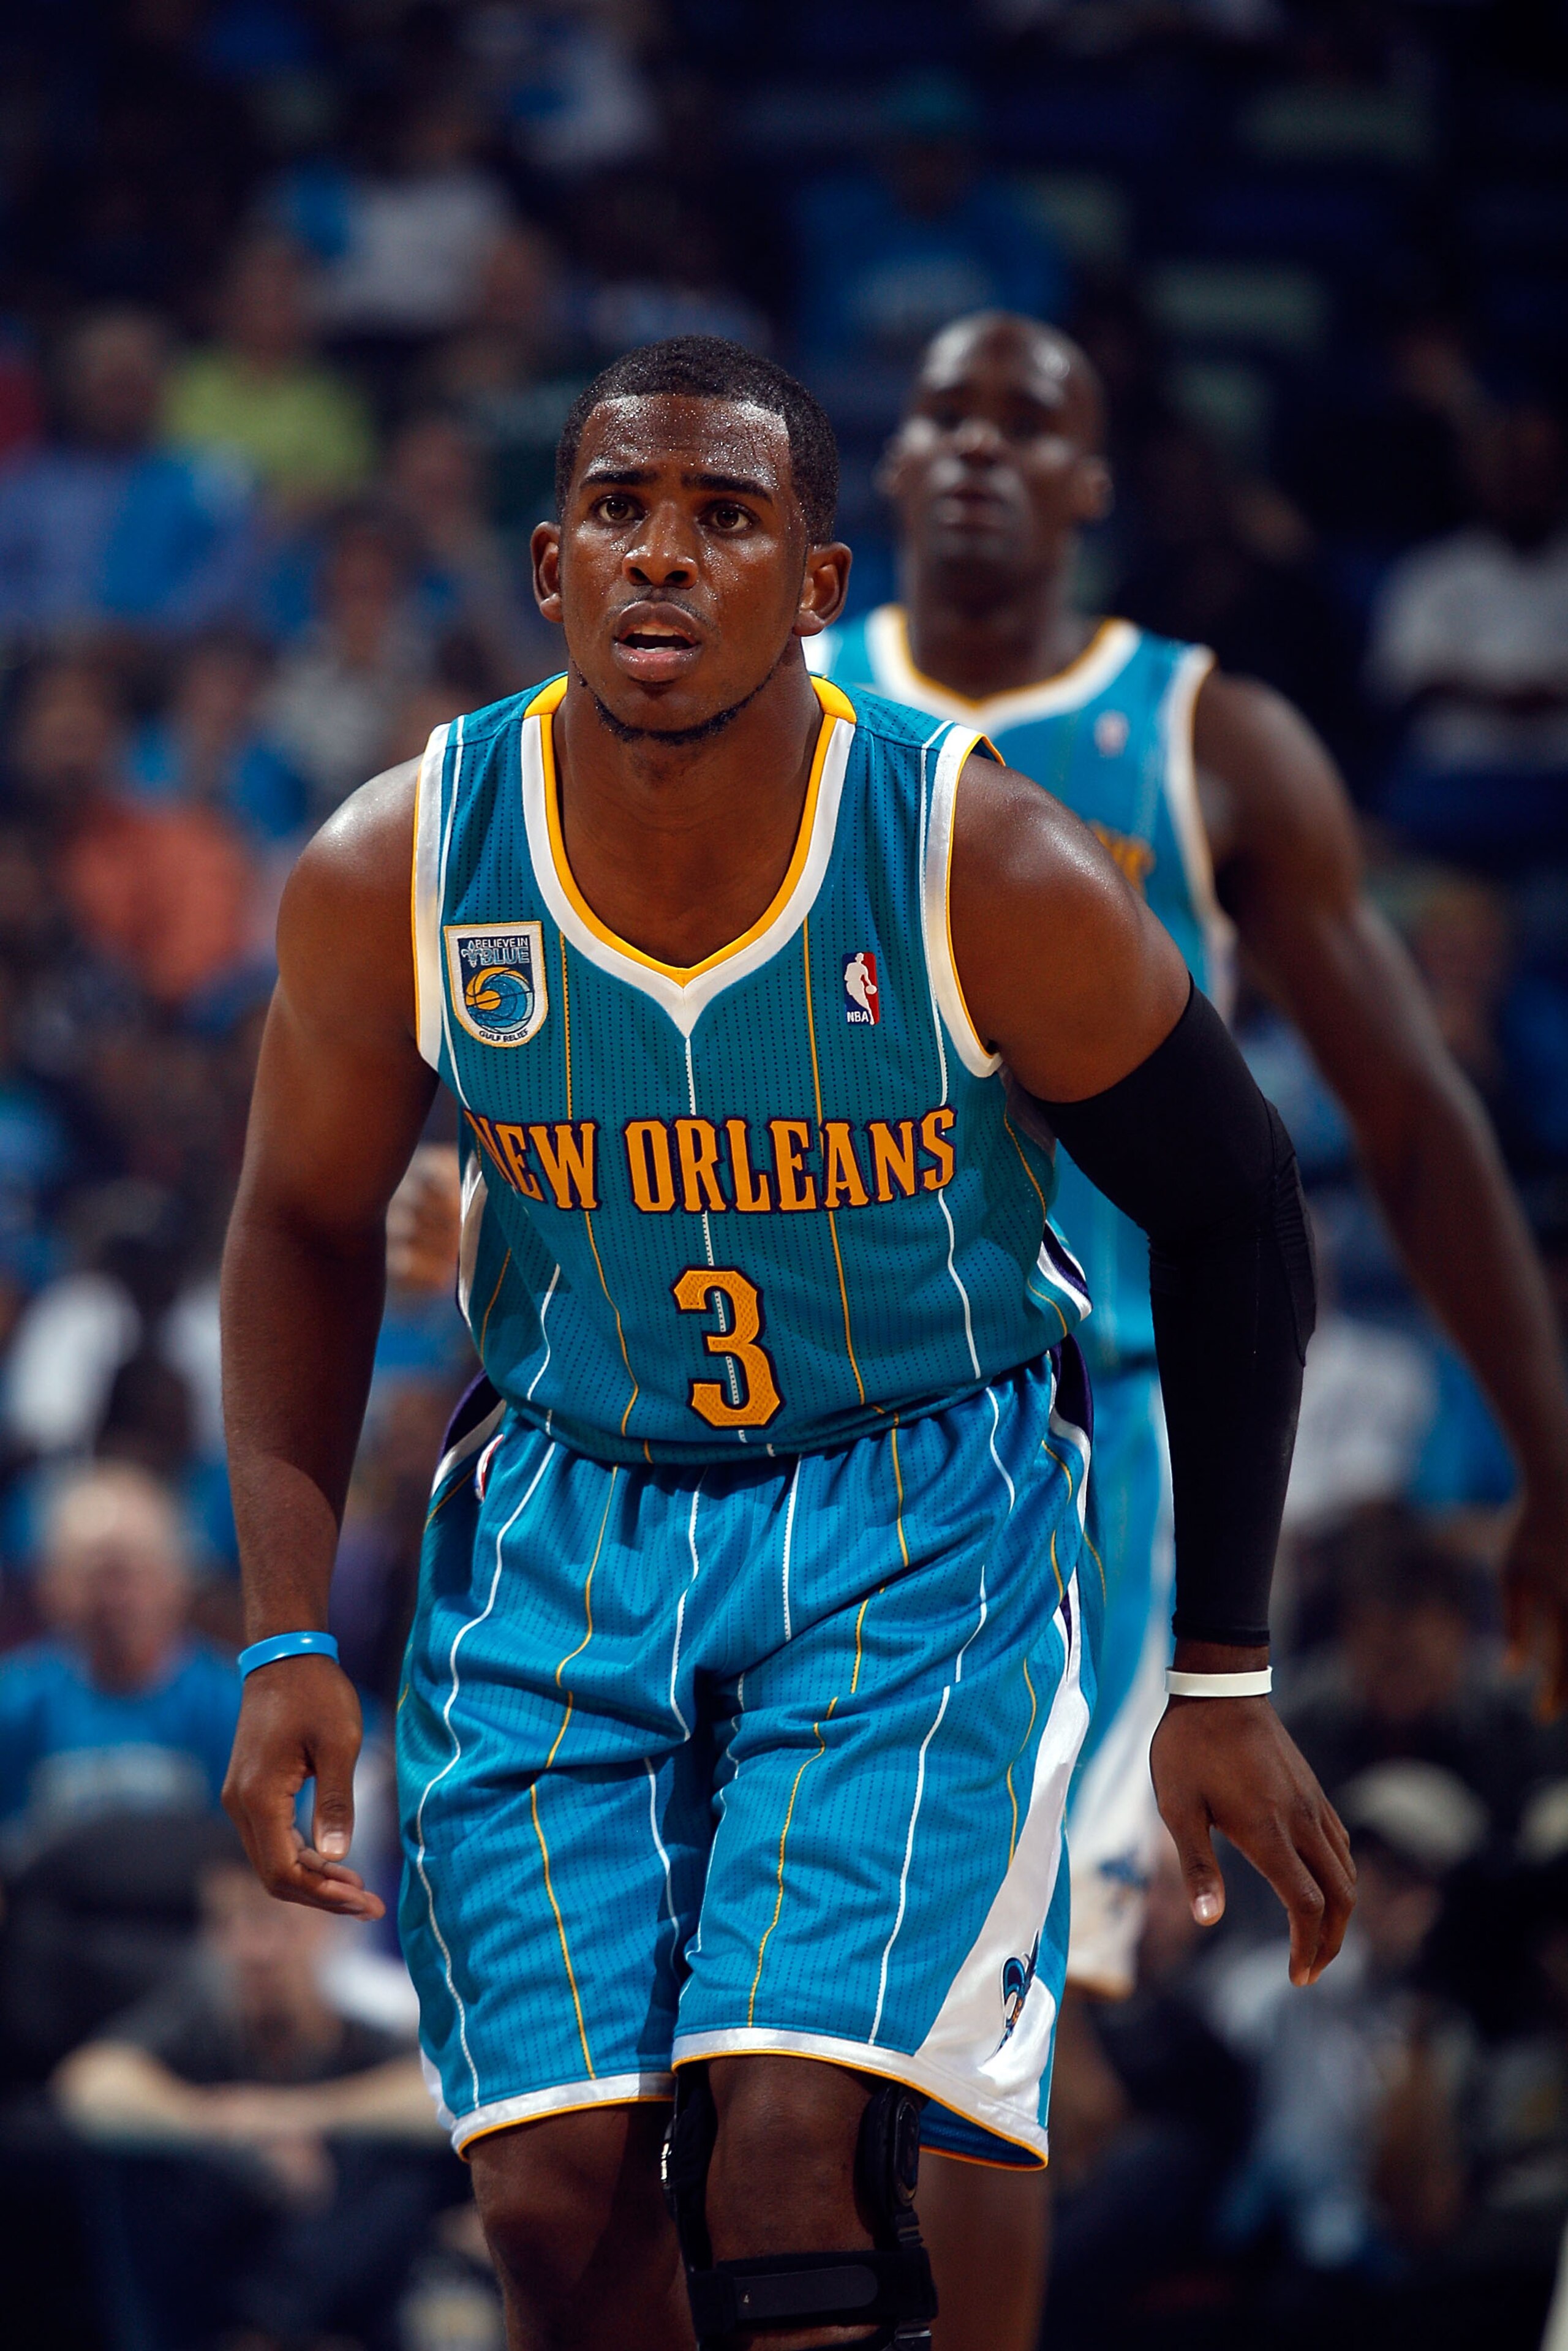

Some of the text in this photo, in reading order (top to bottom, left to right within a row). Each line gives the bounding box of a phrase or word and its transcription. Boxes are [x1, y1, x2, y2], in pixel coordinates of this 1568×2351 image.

[475, 938, 528, 949] BELIEVE IN
[480, 947, 530, 966] BLUE
[846, 1011, 869, 1022] NBA
[479, 1029, 529, 1043] GULF RELIEF
[463, 1105, 957, 1213] NEW ORLEANS
[671, 1266, 786, 1430] 3
